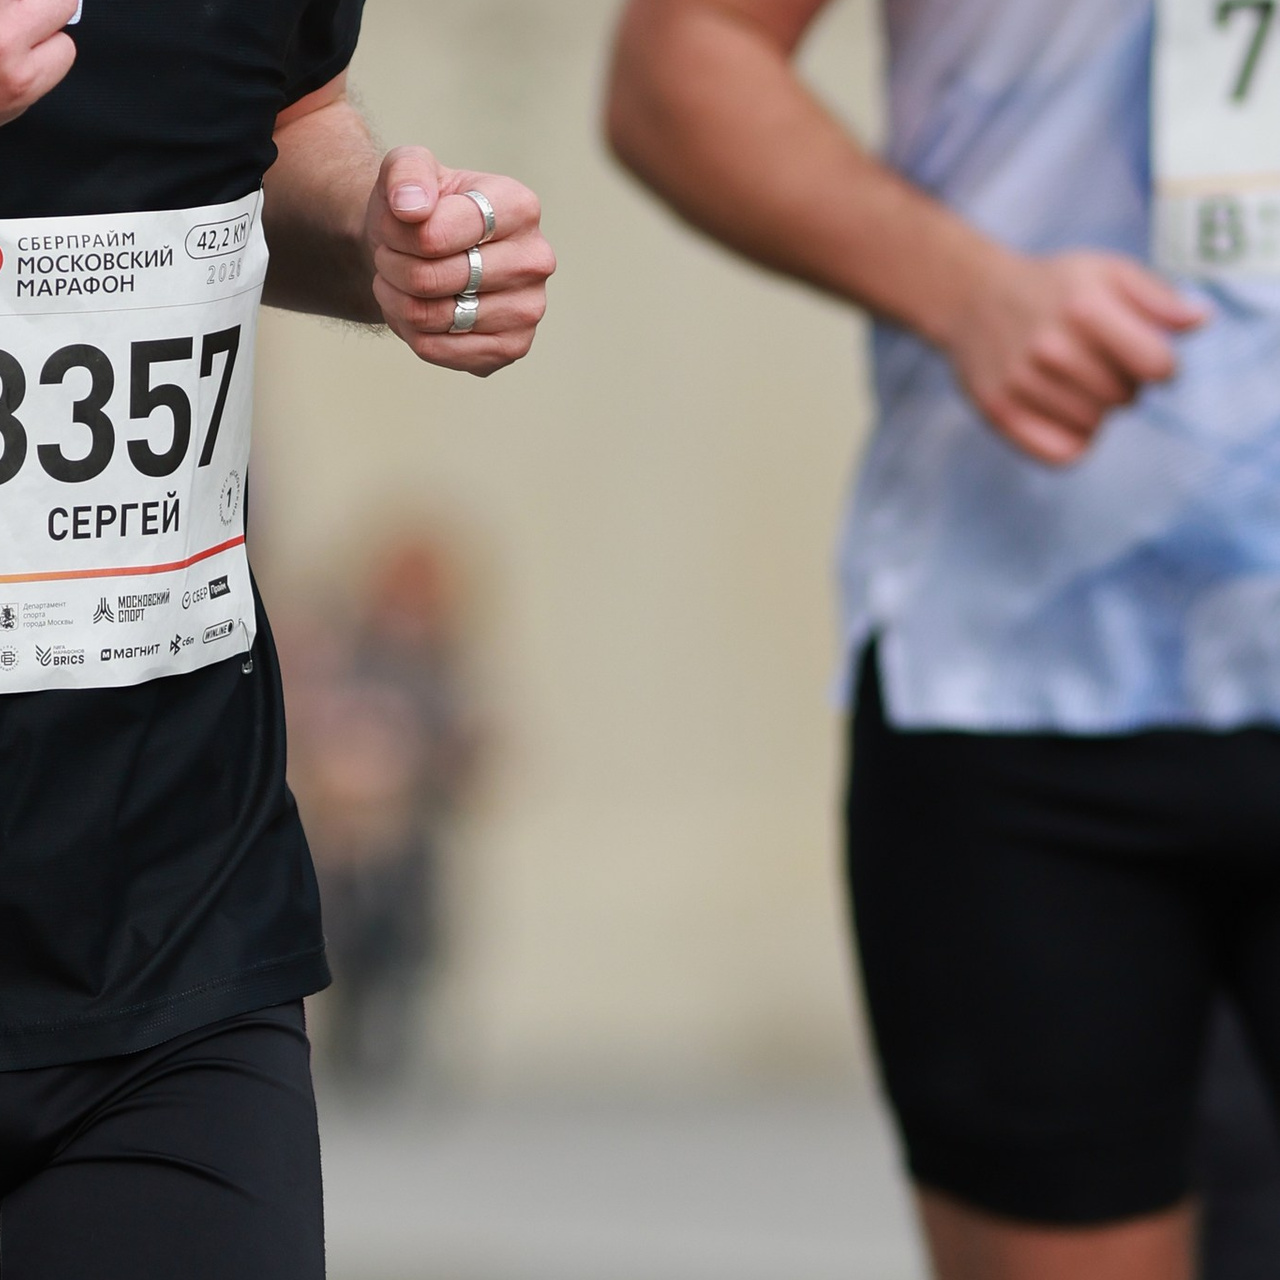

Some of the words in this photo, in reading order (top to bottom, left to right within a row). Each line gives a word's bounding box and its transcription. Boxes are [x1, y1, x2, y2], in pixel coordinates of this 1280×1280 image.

[17, 230, 135, 251] СБЕРПРАЙМ
[197, 227, 230, 251] 42,2
[17, 245, 173, 275] МОСКОВСКИЙ
[17, 274, 135, 297] МАРАФОН
[48, 491, 180, 541] СЕРГЕЙ
[23, 602, 66, 611] Департамент
[118, 589, 170, 608] МОСКОВСКИЙ
[23, 612, 46, 620] спорта
[23, 620, 46, 628] города
[118, 608, 145, 623] СПОРТ
[114, 643, 161, 659] магнит
[53, 654, 85, 666] BRICS
